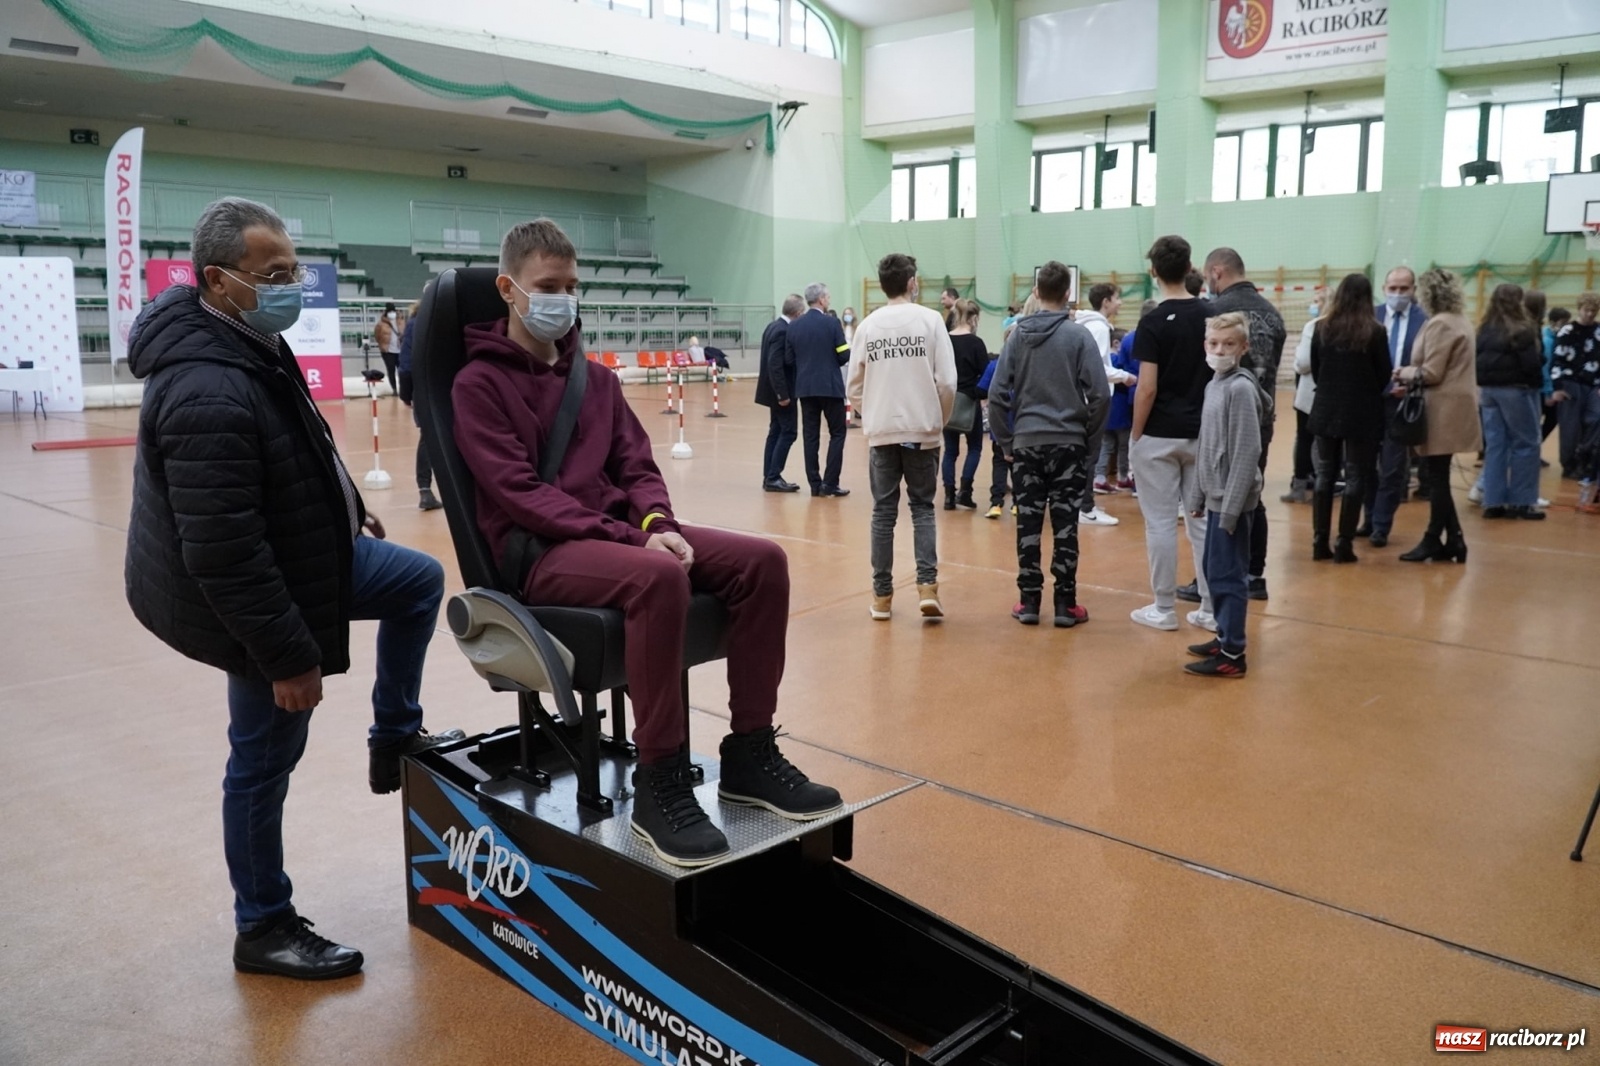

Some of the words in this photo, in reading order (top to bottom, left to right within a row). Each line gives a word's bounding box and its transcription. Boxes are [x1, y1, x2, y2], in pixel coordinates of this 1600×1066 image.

[1296, 0, 1373, 12] MIA
[1282, 7, 1388, 39] RACIBÓRZ
[117, 153, 134, 312] RACIBÓRZ
[867, 336, 926, 352] BONJOUR
[867, 352, 881, 363] AU
[884, 346, 927, 360] REVOIR
[307, 368, 322, 383] R
[442, 825, 531, 902] WORD
[492, 921, 539, 960] KATOWICE
[581, 965, 761, 1066] WWW.WORD.K
